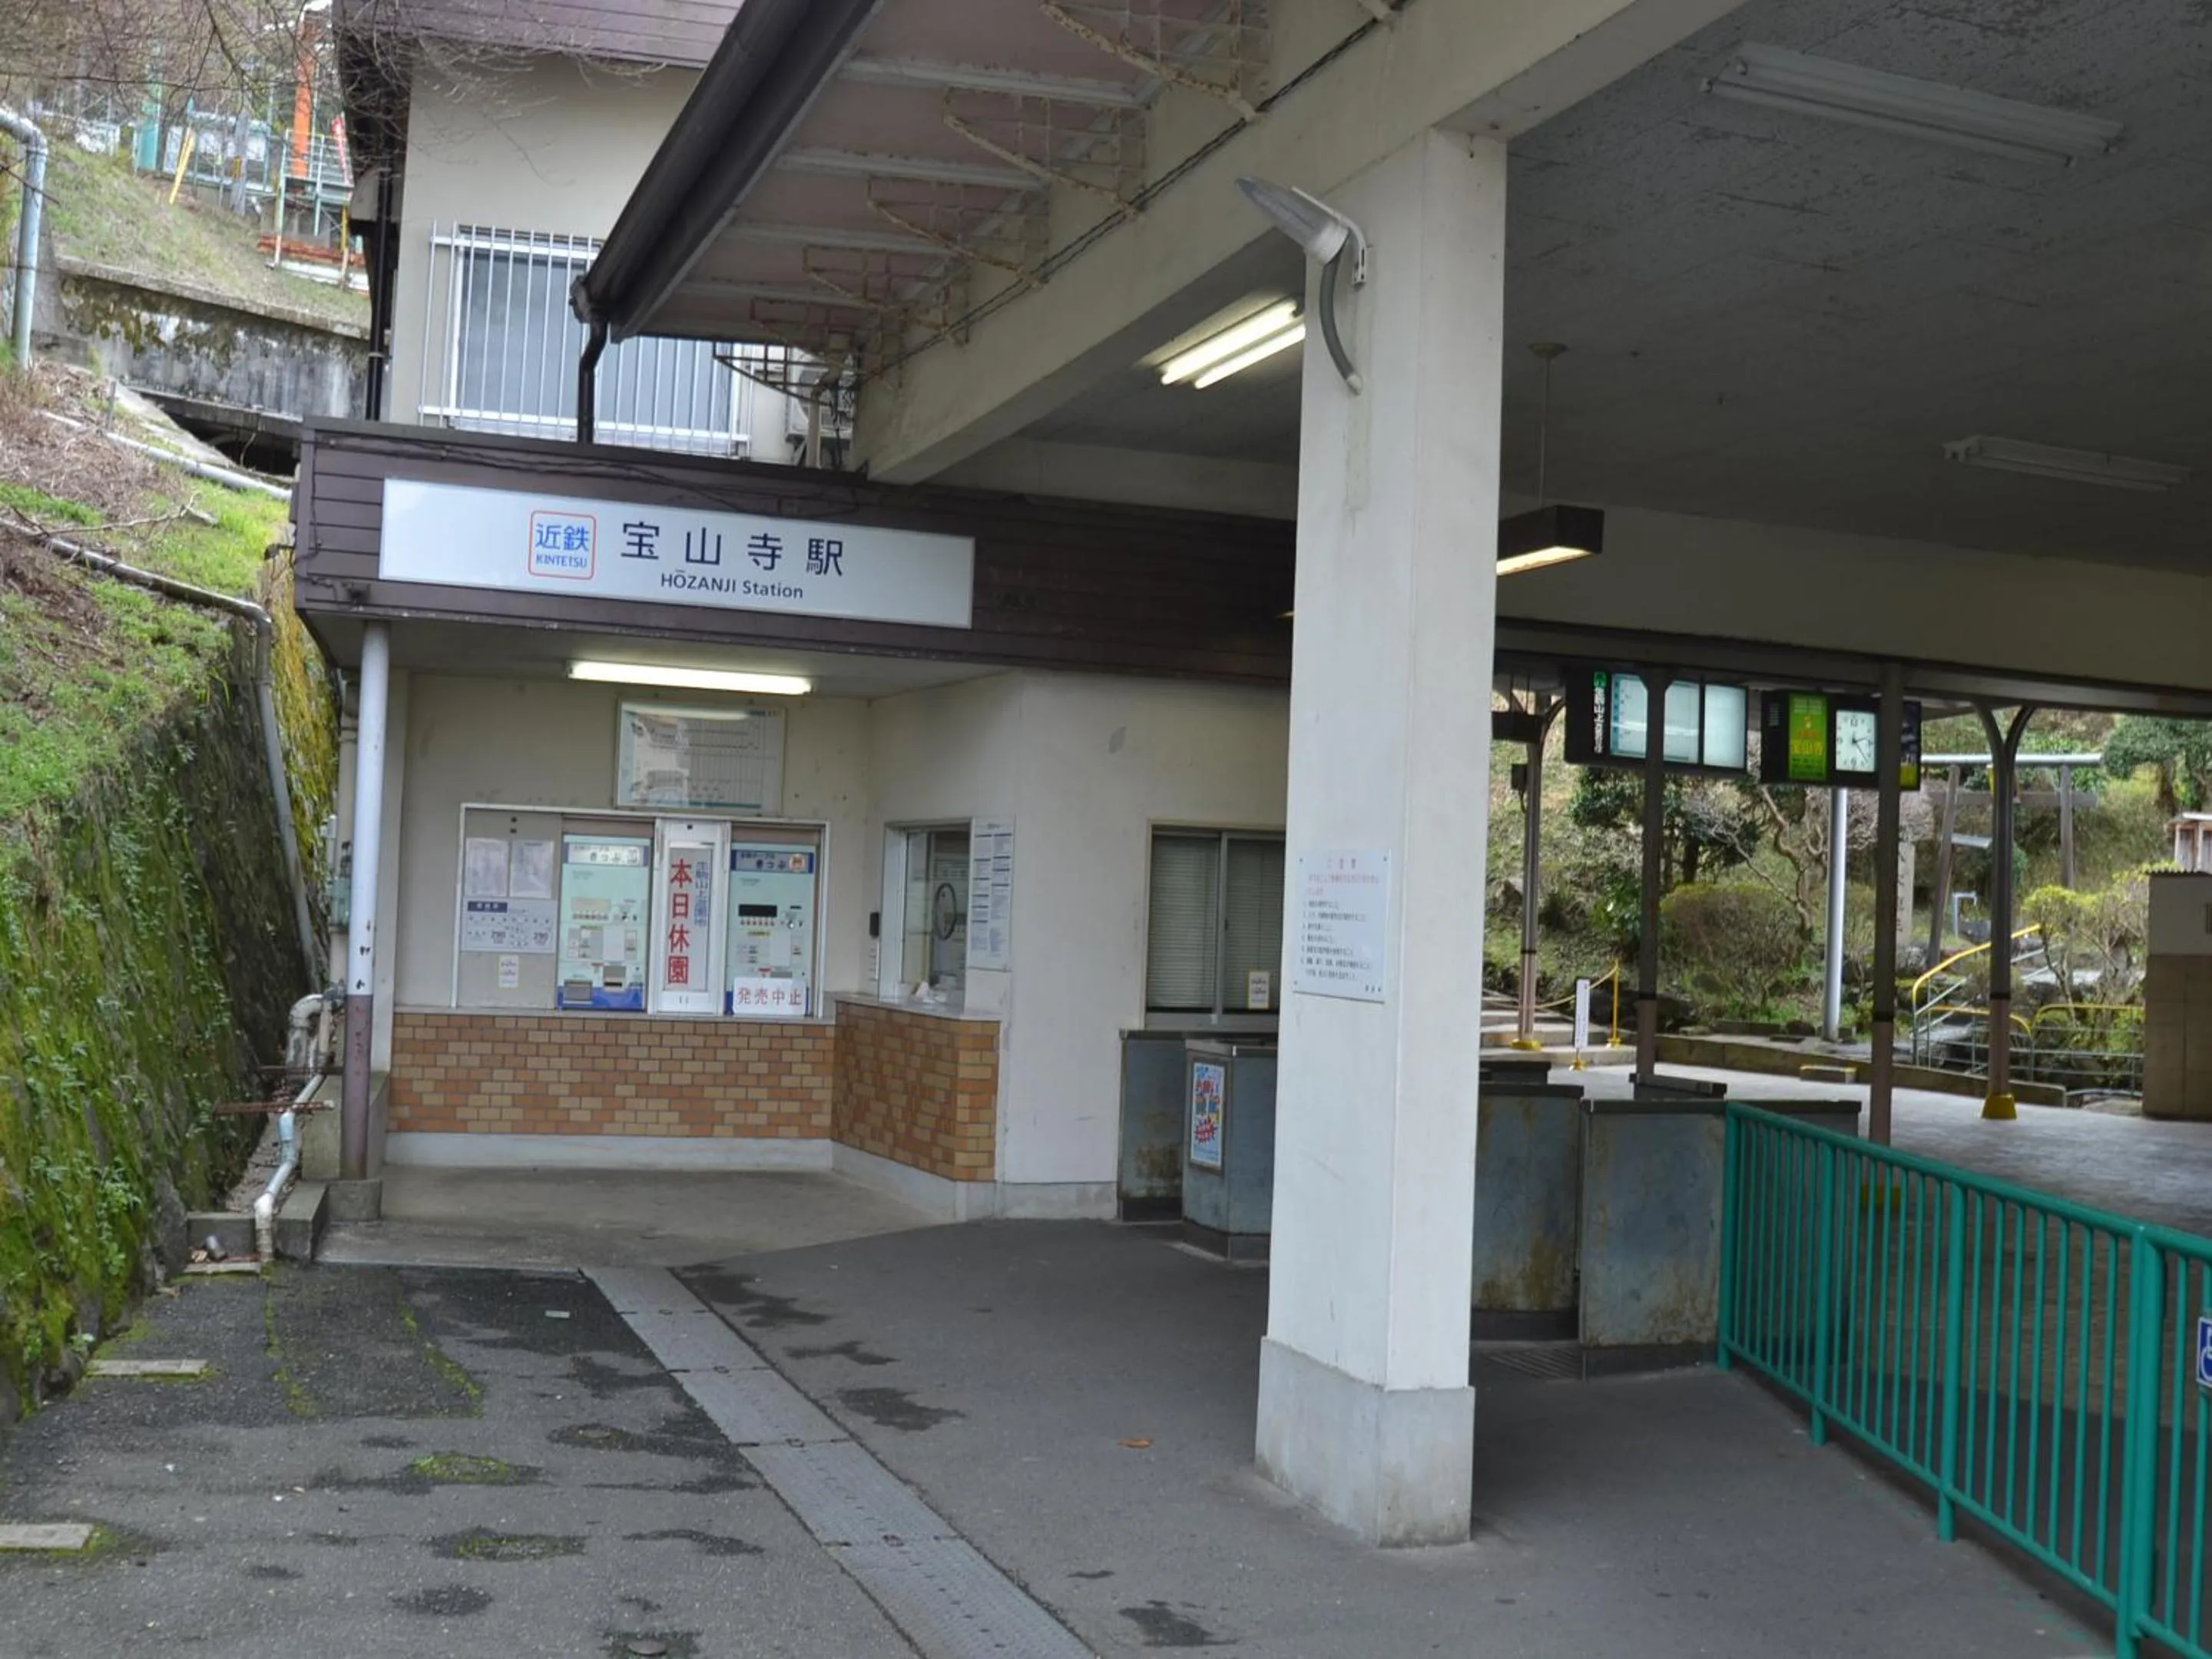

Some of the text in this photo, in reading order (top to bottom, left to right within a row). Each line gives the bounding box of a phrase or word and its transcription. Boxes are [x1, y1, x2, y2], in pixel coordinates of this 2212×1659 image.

[535, 523, 590, 552] 近鉄
[621, 521, 843, 577] 宝山寺駅
[535, 554, 588, 569] KINTETSU
[661, 569, 803, 599] HŌZANJI Station
[669, 858, 693, 985] 本日休園
[737, 987, 803, 1006] 発売中止
